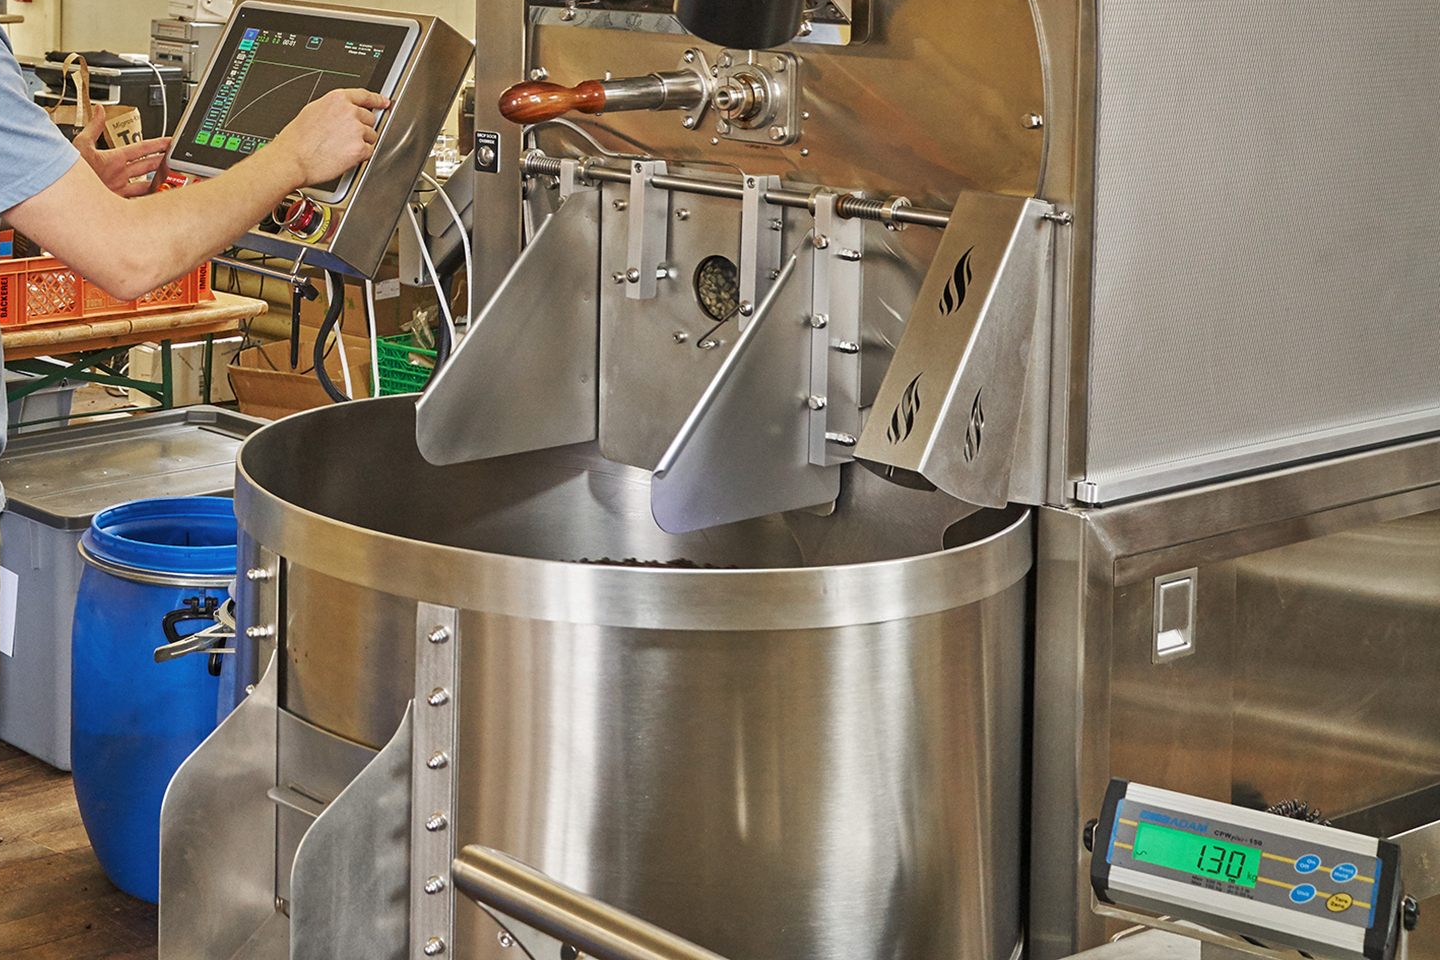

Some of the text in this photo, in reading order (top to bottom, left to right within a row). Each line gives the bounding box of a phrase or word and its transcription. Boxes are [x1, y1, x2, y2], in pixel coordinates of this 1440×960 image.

[199, 264, 207, 289] IMHOL
[0, 277, 8, 318] BÄCKEREI
[1169, 817, 1208, 833] ADAM
[1196, 844, 1257, 883] 1.30 kg
[1296, 889, 1309, 897] Unit
[1334, 896, 1348, 904] Tare
